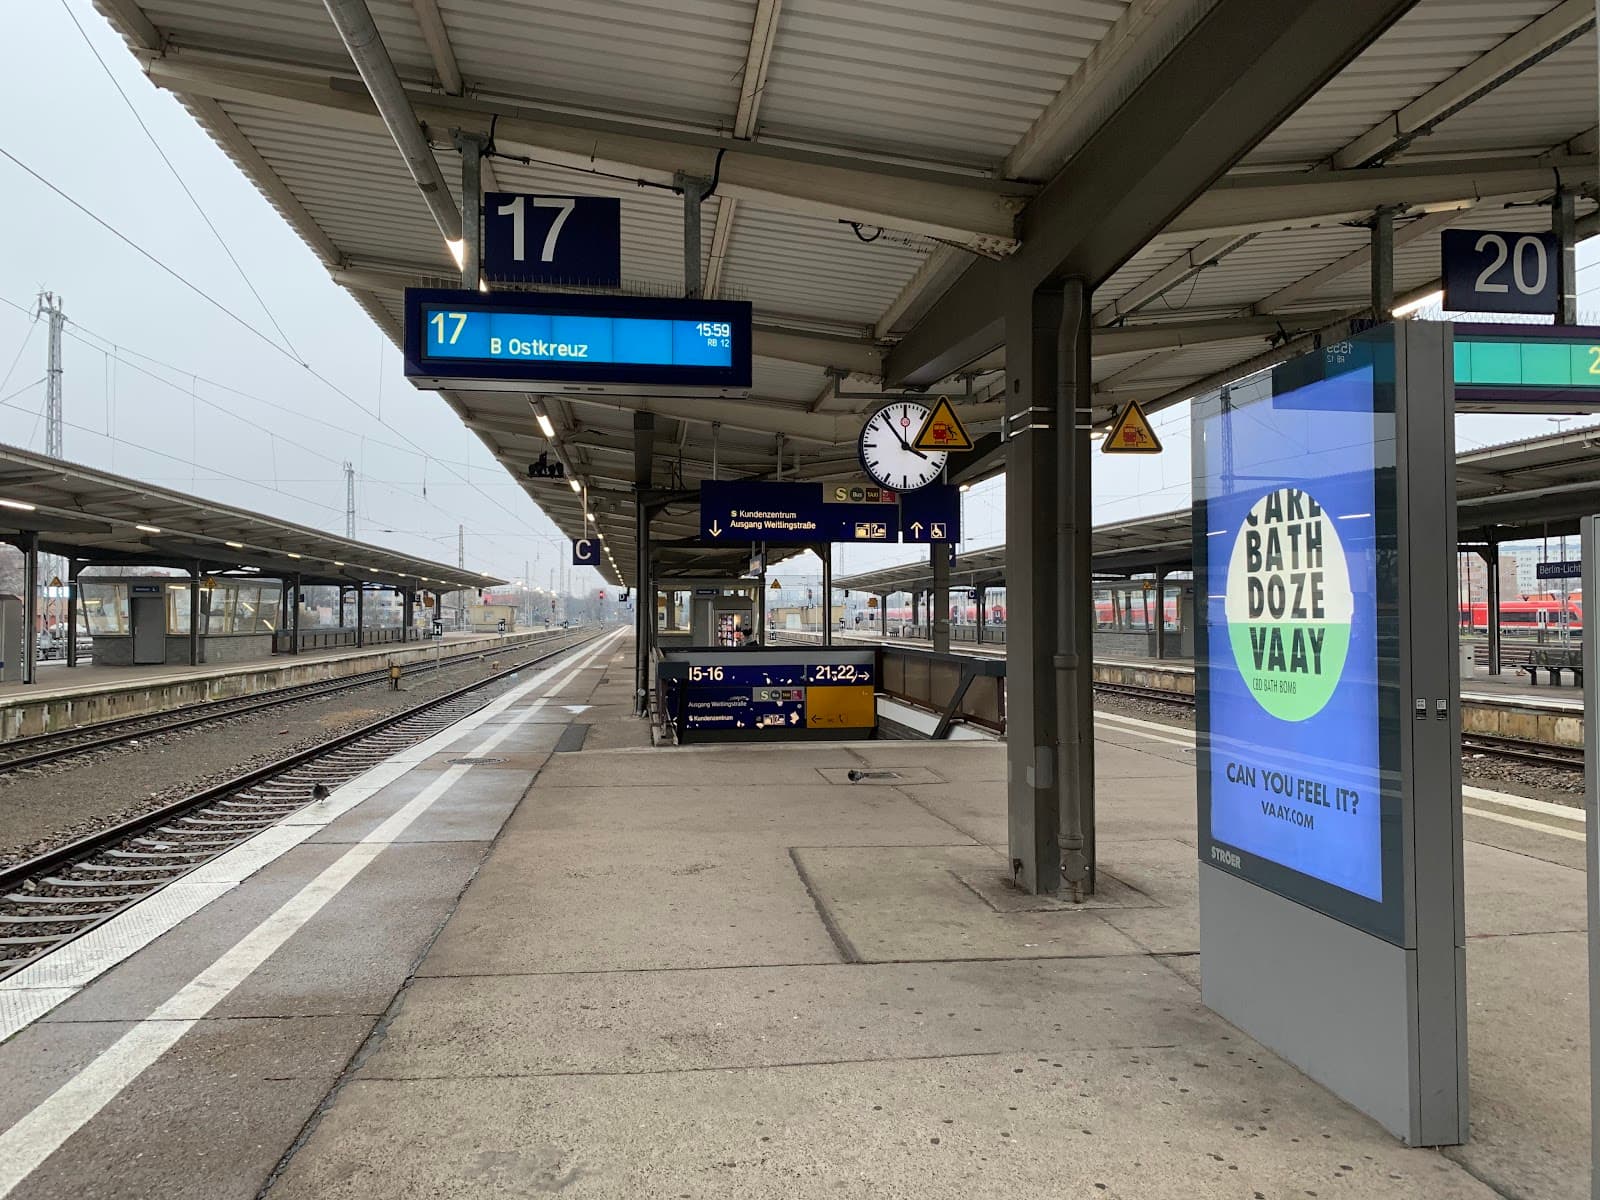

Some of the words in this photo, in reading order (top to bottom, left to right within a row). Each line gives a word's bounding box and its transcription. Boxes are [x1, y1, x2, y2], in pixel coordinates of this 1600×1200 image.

[498, 196, 576, 262] 17
[1474, 234, 1548, 295] 20
[430, 313, 468, 345] 17
[696, 323, 730, 337] 15:59
[490, 338, 501, 354] B
[508, 338, 588, 358] Ostkreuz
[707, 338, 718, 347] RB
[720, 339, 730, 348] 12
[730, 520, 762, 530] Ausgang
[740, 510, 797, 519] Kundenzentrum
[576, 539, 591, 560] C
[1246, 520, 1323, 573] BATH
[1247, 572, 1325, 619] DOZE
[1249, 627, 1326, 675] VAAY
[688, 666, 723, 681] 15-16
[815, 665, 855, 680] 21-22
[1264, 679, 1278, 693] BATH
[1279, 681, 1296, 694] BOMB
[1226, 763, 1256, 787] CAN
[1262, 769, 1293, 797] YOU
[1297, 779, 1330, 808] FEEL
[1336, 787, 1359, 815] IT?
[1261, 801, 1314, 830] VAAY.COM
